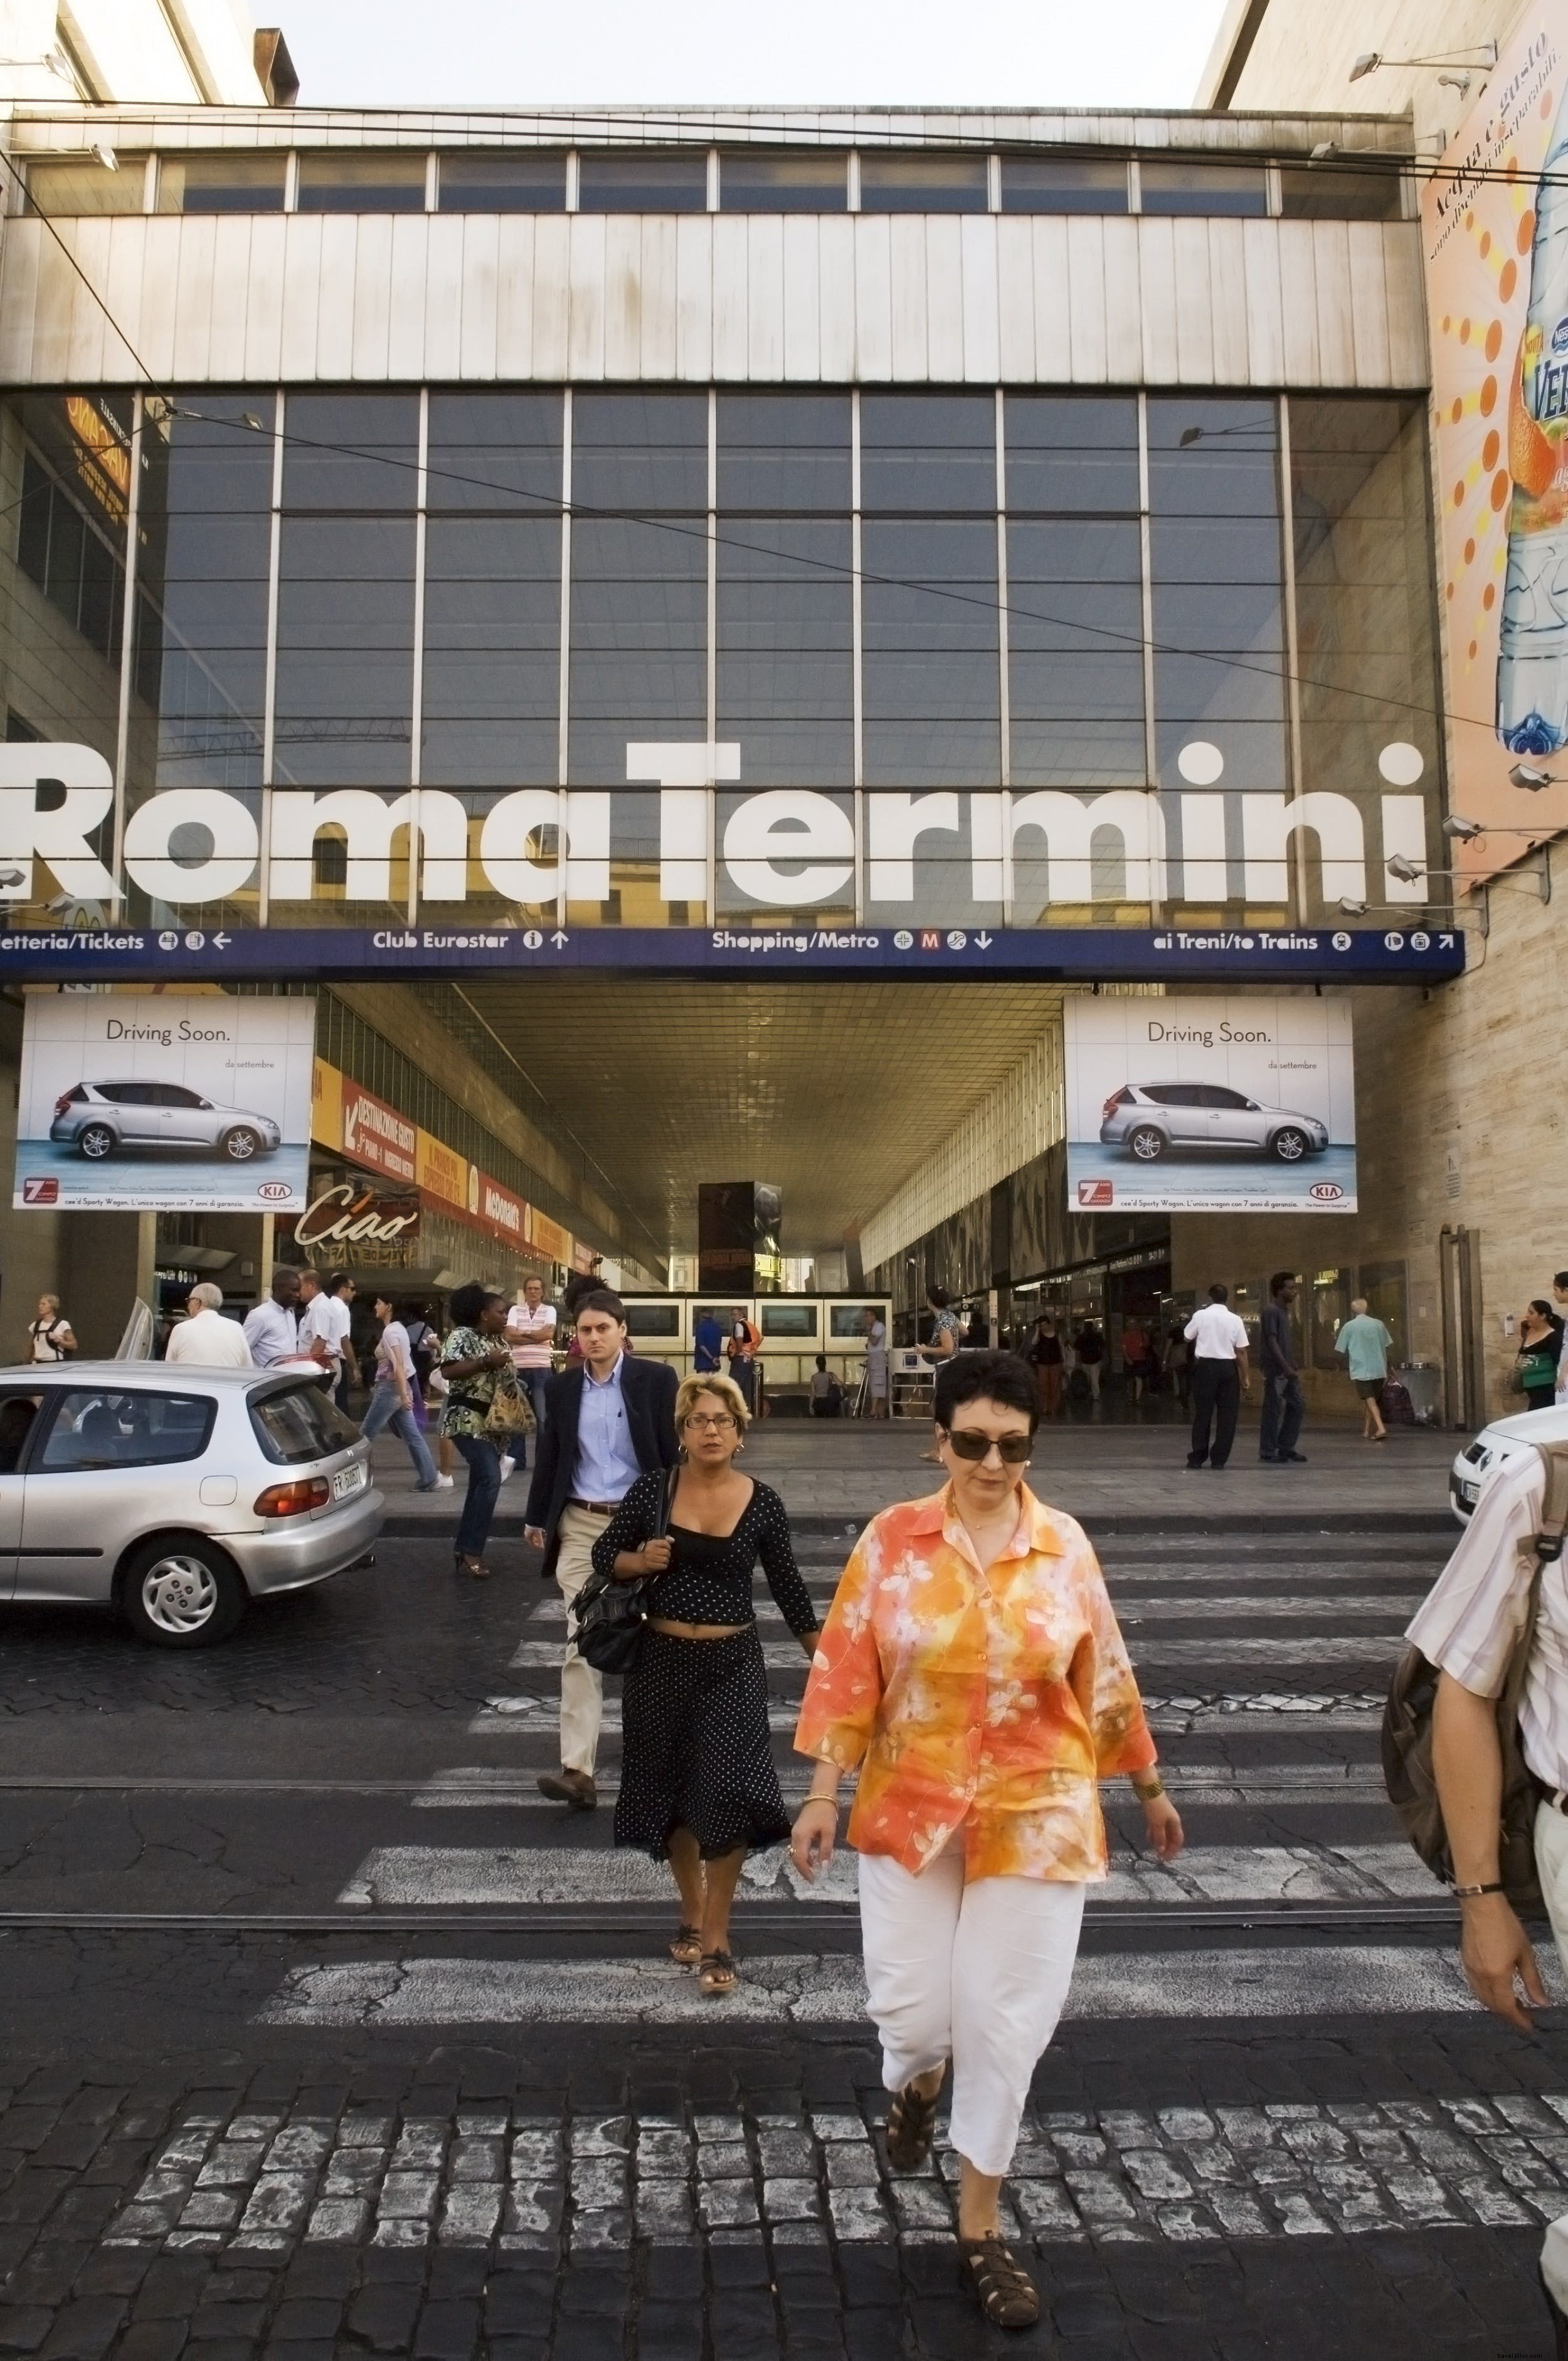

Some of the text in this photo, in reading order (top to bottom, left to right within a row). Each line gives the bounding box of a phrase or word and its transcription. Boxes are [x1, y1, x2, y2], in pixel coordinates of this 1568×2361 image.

[373, 931, 509, 948] Club Eurostar
[712, 931, 879, 952] Shopping/Metro
[1153, 933, 1172, 950] ai
[1258, 933, 1318, 950] Trains
[107, 1019, 230, 1046] Driving Soon.
[1148, 1022, 1271, 1048] Driving Soon.
[236, 1059, 275, 1069] settembre
[1279, 1061, 1316, 1069] settembre
[359, 1095, 415, 1155] DESTINAZIONE GUSTO
[26, 1180, 46, 1201] 7
[263, 1186, 287, 1196] KIA
[1080, 1182, 1099, 1203] 7
[1315, 1187, 1338, 1197] KIA
[83, 1197, 103, 1207] Sporty
[485, 1186, 520, 1233] McDonald's
[1138, 1199, 1159, 1208] Sporty
[294, 1184, 418, 1246] Ciao
